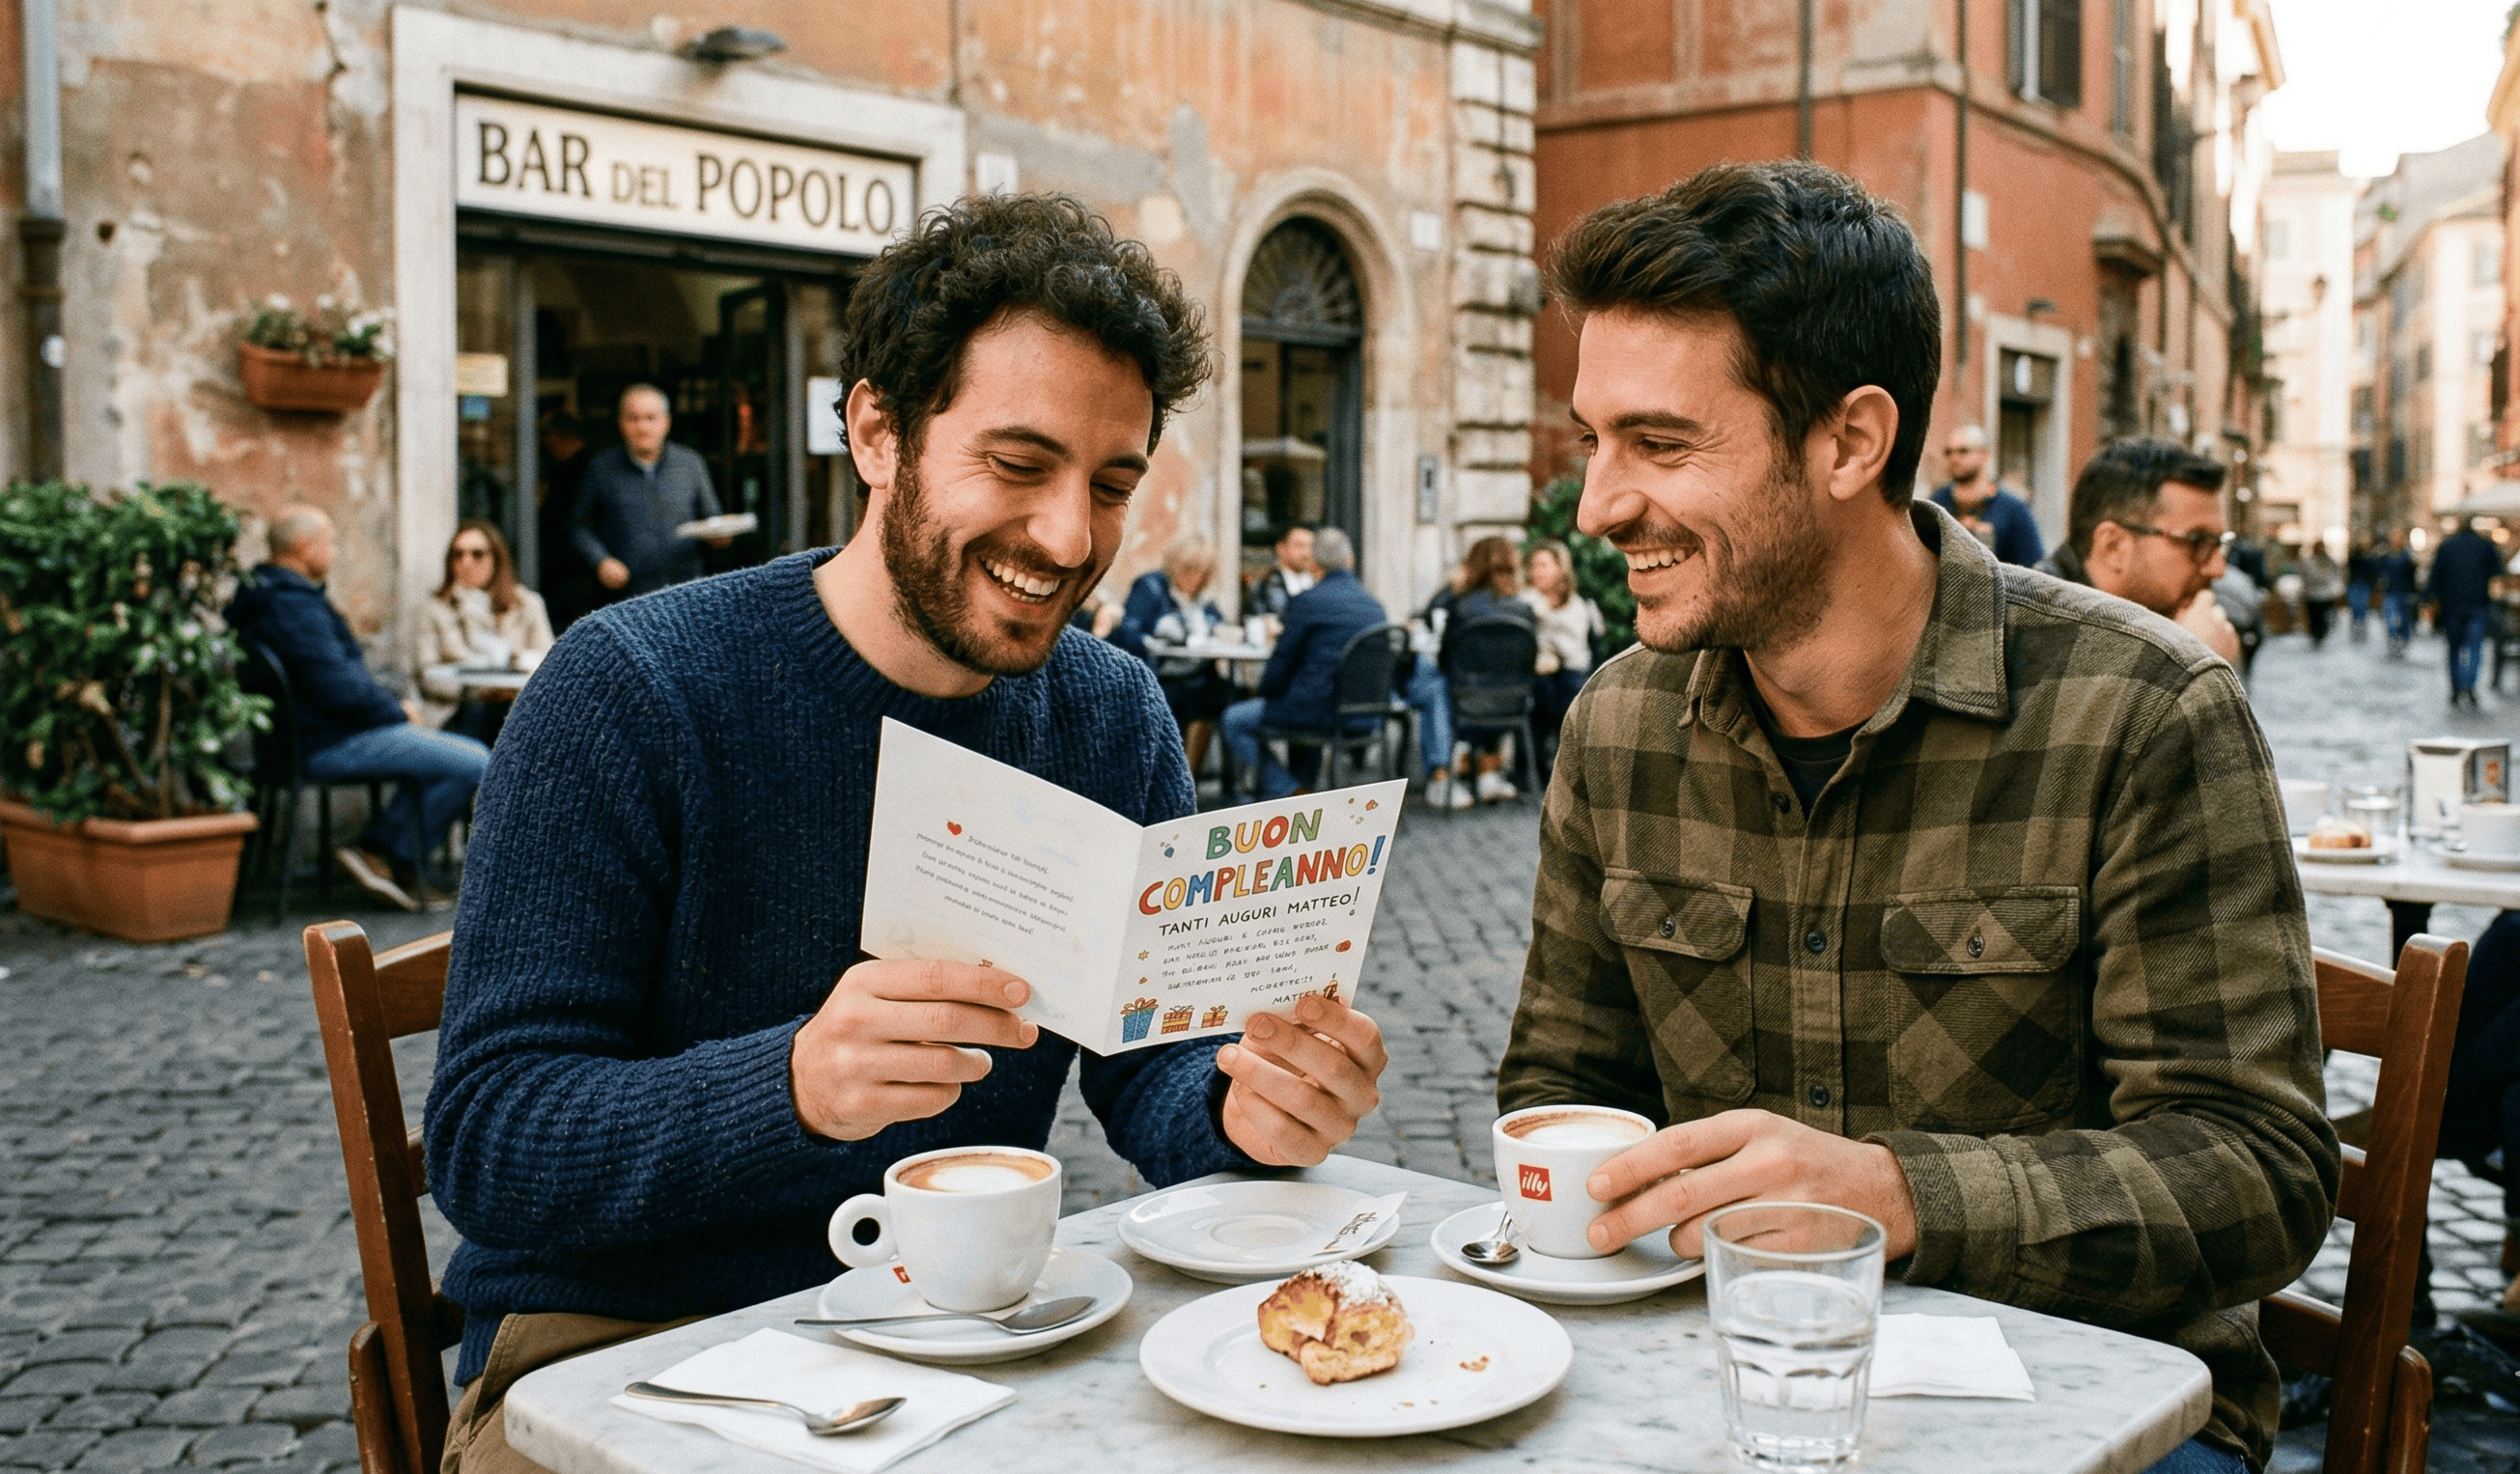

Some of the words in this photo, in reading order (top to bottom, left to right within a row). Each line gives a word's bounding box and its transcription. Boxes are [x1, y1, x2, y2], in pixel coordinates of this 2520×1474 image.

[478, 121, 592, 198] BAR
[611, 161, 679, 210] DEL
[696, 153, 895, 236] POPOLO
[1206, 808, 1324, 860] BUON
[1138, 835, 1386, 916] COMPLEANNO!
[1159, 917, 1209, 936] TANTI
[1218, 905, 1277, 927] AUGURI
[1287, 886, 1359, 914] MATTEO!
[1521, 1170, 1549, 1197] illy
